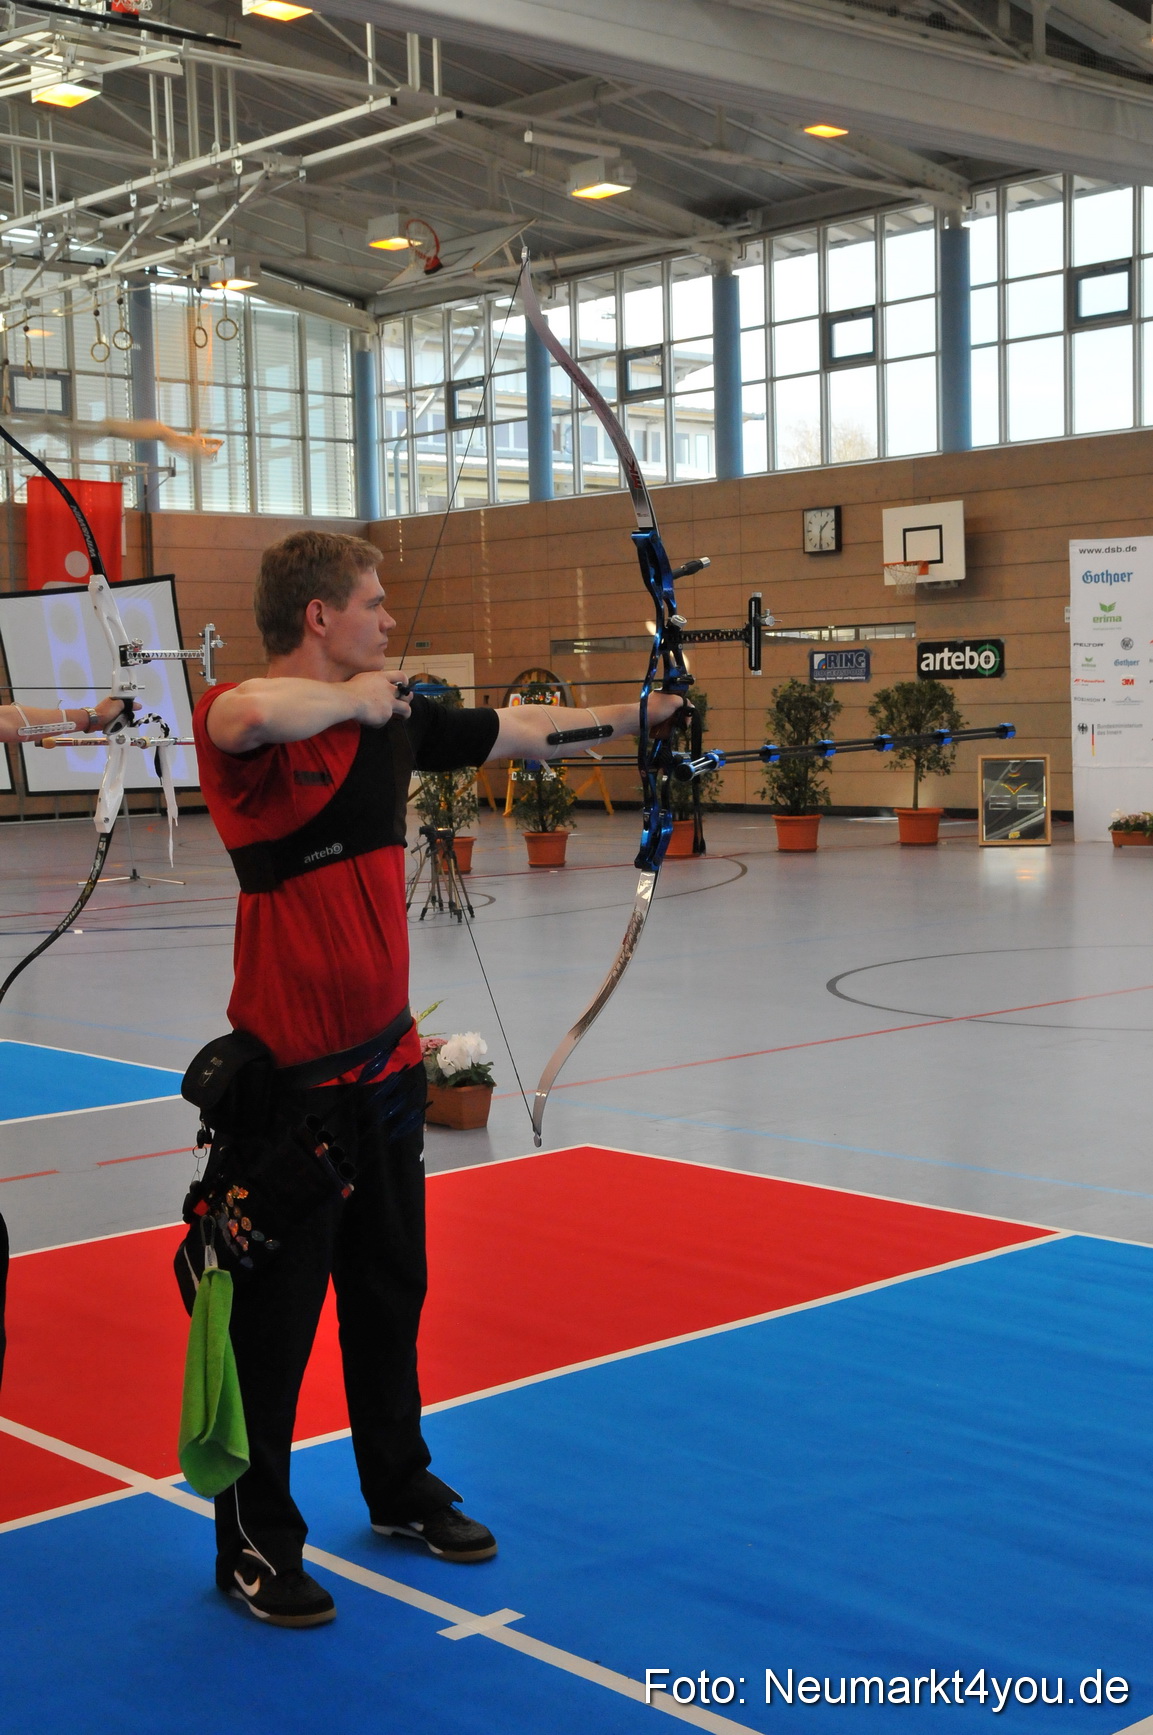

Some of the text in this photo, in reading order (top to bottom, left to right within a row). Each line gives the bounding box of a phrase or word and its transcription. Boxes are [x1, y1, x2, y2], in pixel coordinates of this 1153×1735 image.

[1078, 545, 1137, 554] www.dsb.de
[1082, 569, 1133, 586] Gothaer
[1092, 614, 1122, 624] erima
[826, 652, 866, 669] RING
[920, 646, 996, 672] artebo
[1114, 659, 1140, 667] Gothaer
[1121, 678, 1134, 686] 3M
[303, 842, 343, 864] artebo
